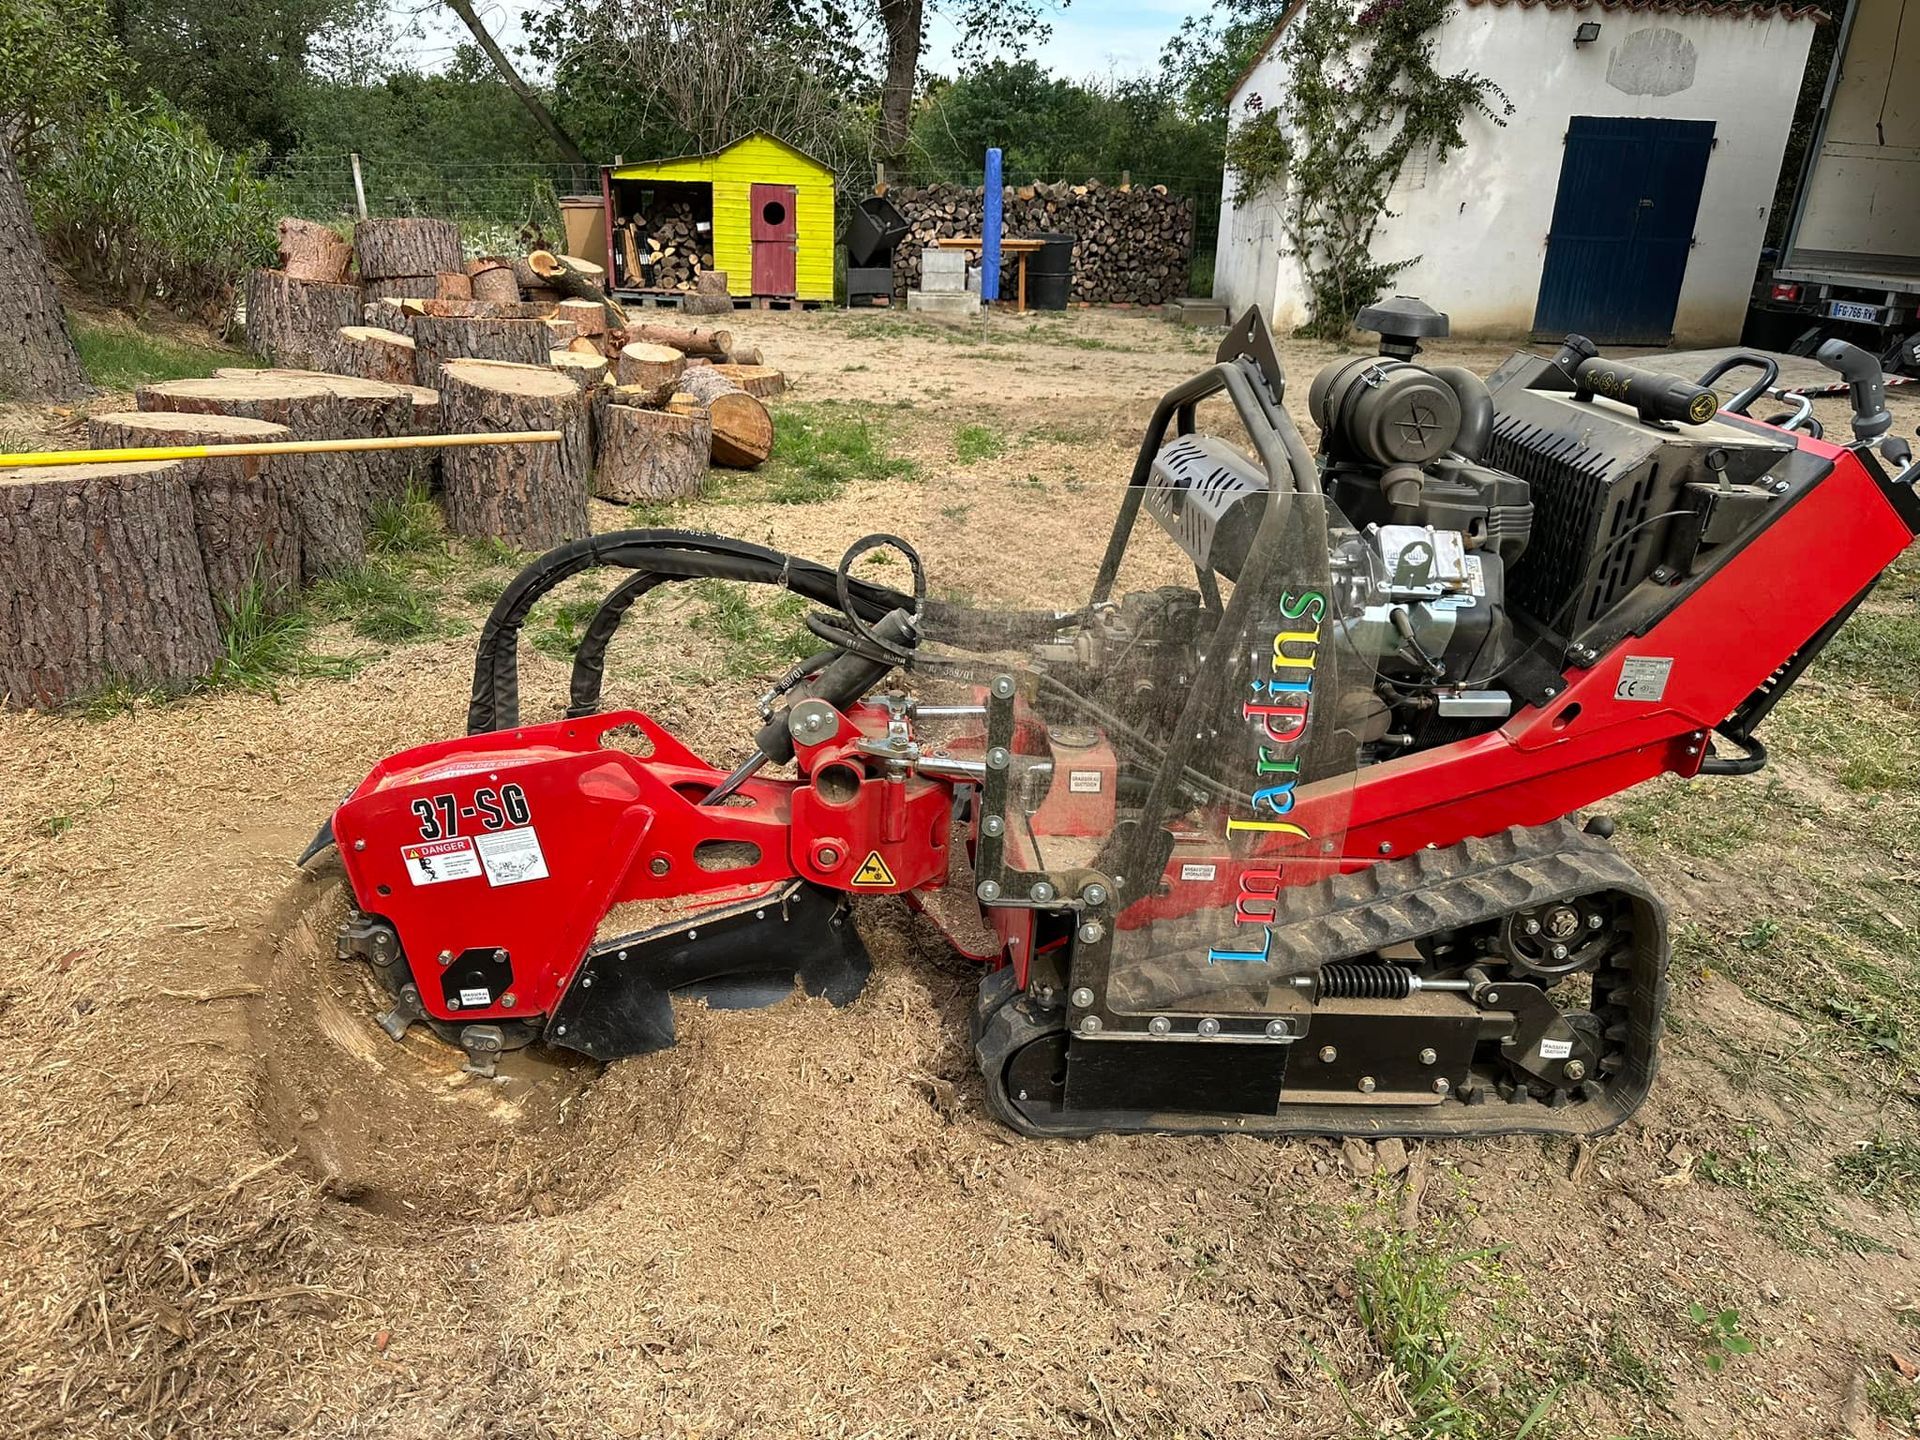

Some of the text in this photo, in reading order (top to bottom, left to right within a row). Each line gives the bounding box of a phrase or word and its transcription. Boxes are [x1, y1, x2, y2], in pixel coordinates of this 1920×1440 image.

[1208, 590, 1327, 967] Lm Jardins
[411, 783, 531, 841] 37-SG
[421, 841, 466, 855] DANGER
